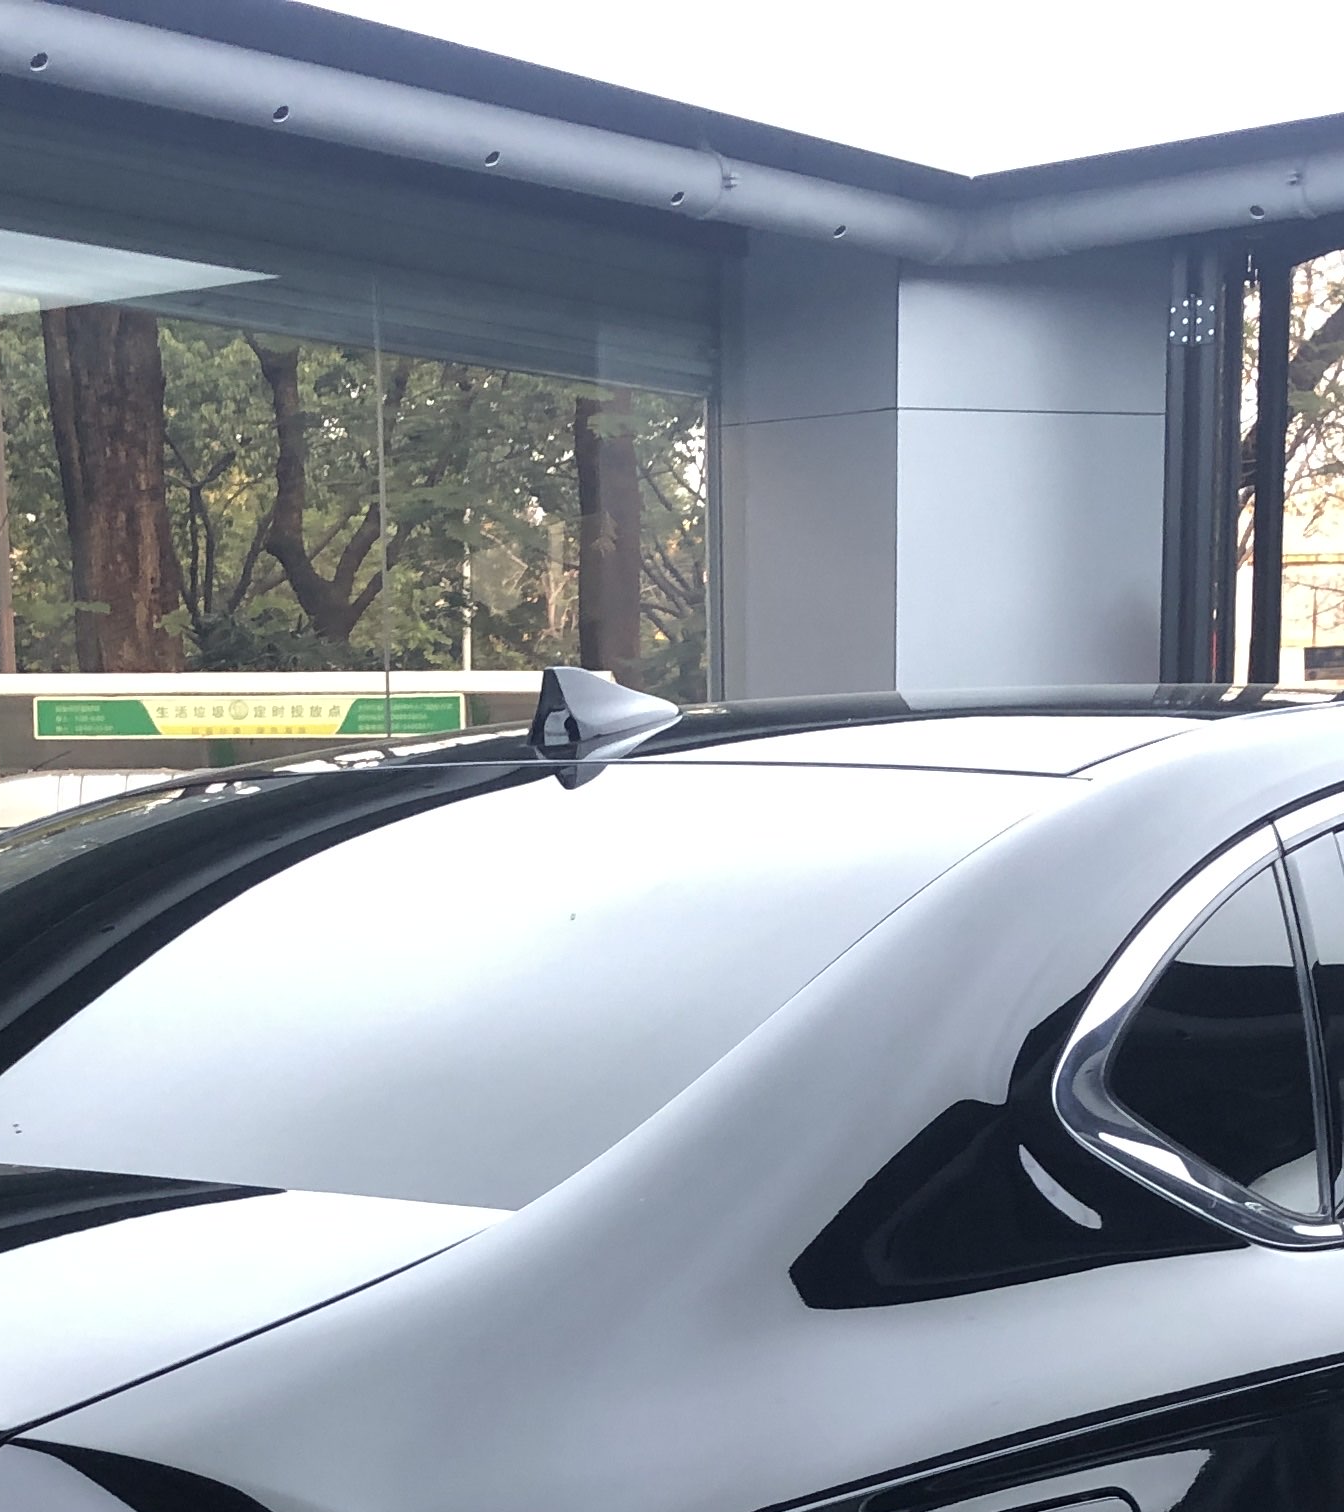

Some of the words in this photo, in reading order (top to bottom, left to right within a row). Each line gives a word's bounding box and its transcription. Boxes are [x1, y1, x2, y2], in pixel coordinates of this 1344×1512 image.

[155, 705, 225, 719] 生活垃圾
[253, 704, 341, 719] 定时投放点
